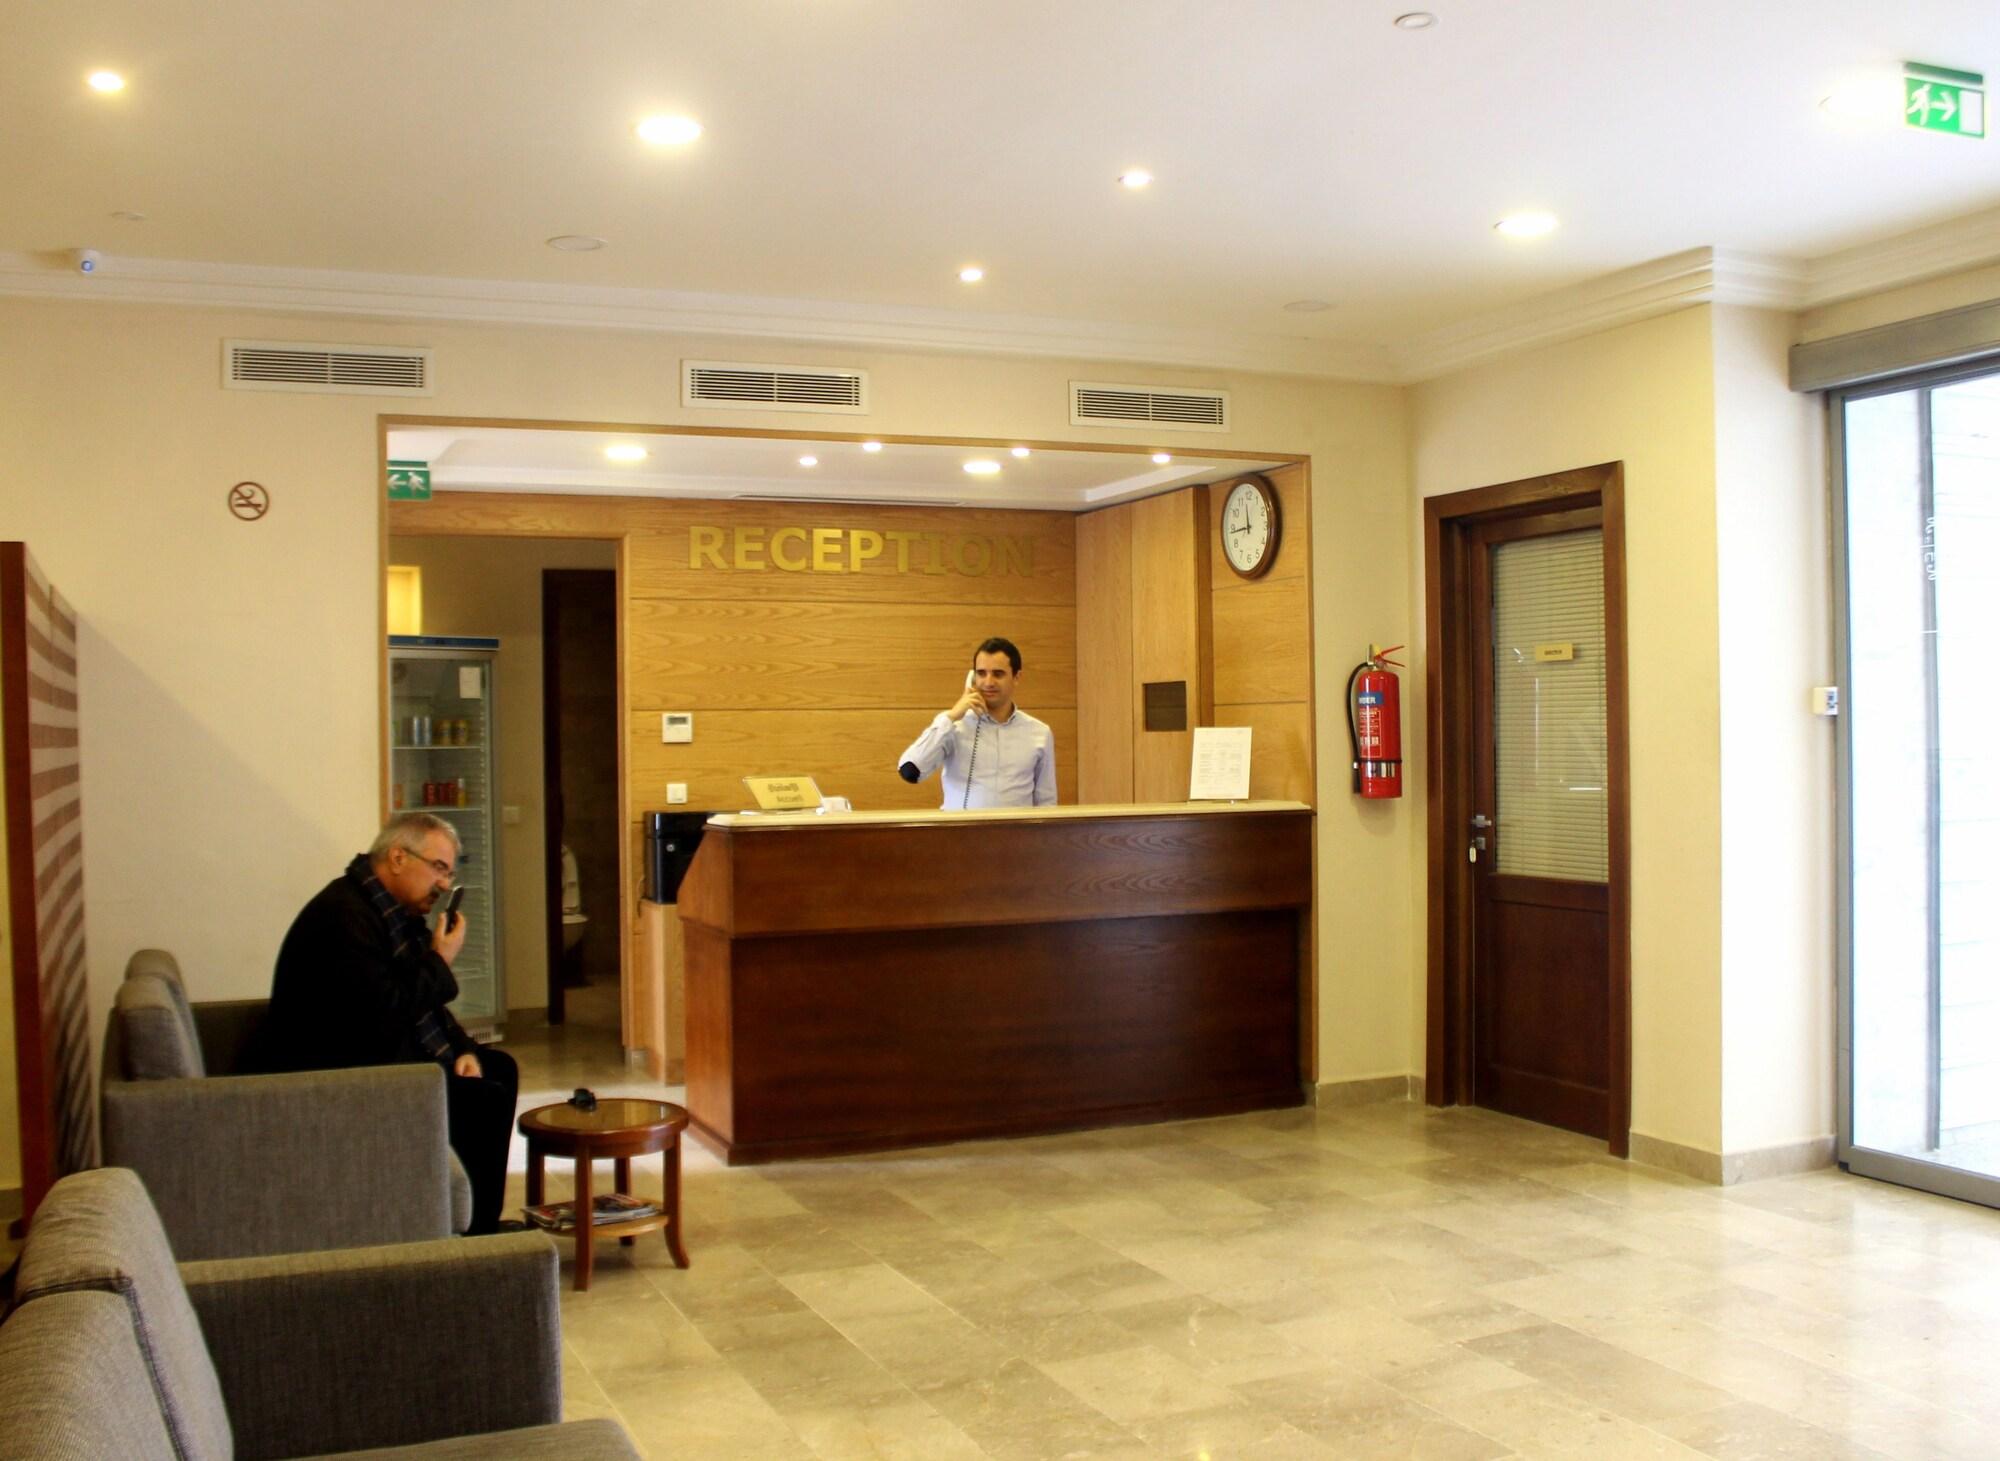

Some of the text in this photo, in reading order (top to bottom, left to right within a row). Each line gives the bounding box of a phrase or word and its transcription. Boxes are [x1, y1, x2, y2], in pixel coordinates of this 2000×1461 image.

[1245, 490, 1253, 501] 12
[1239, 498, 1244, 506] 11
[1233, 508, 1240, 518] 10
[688, 526, 1035, 577] RECEPTION
